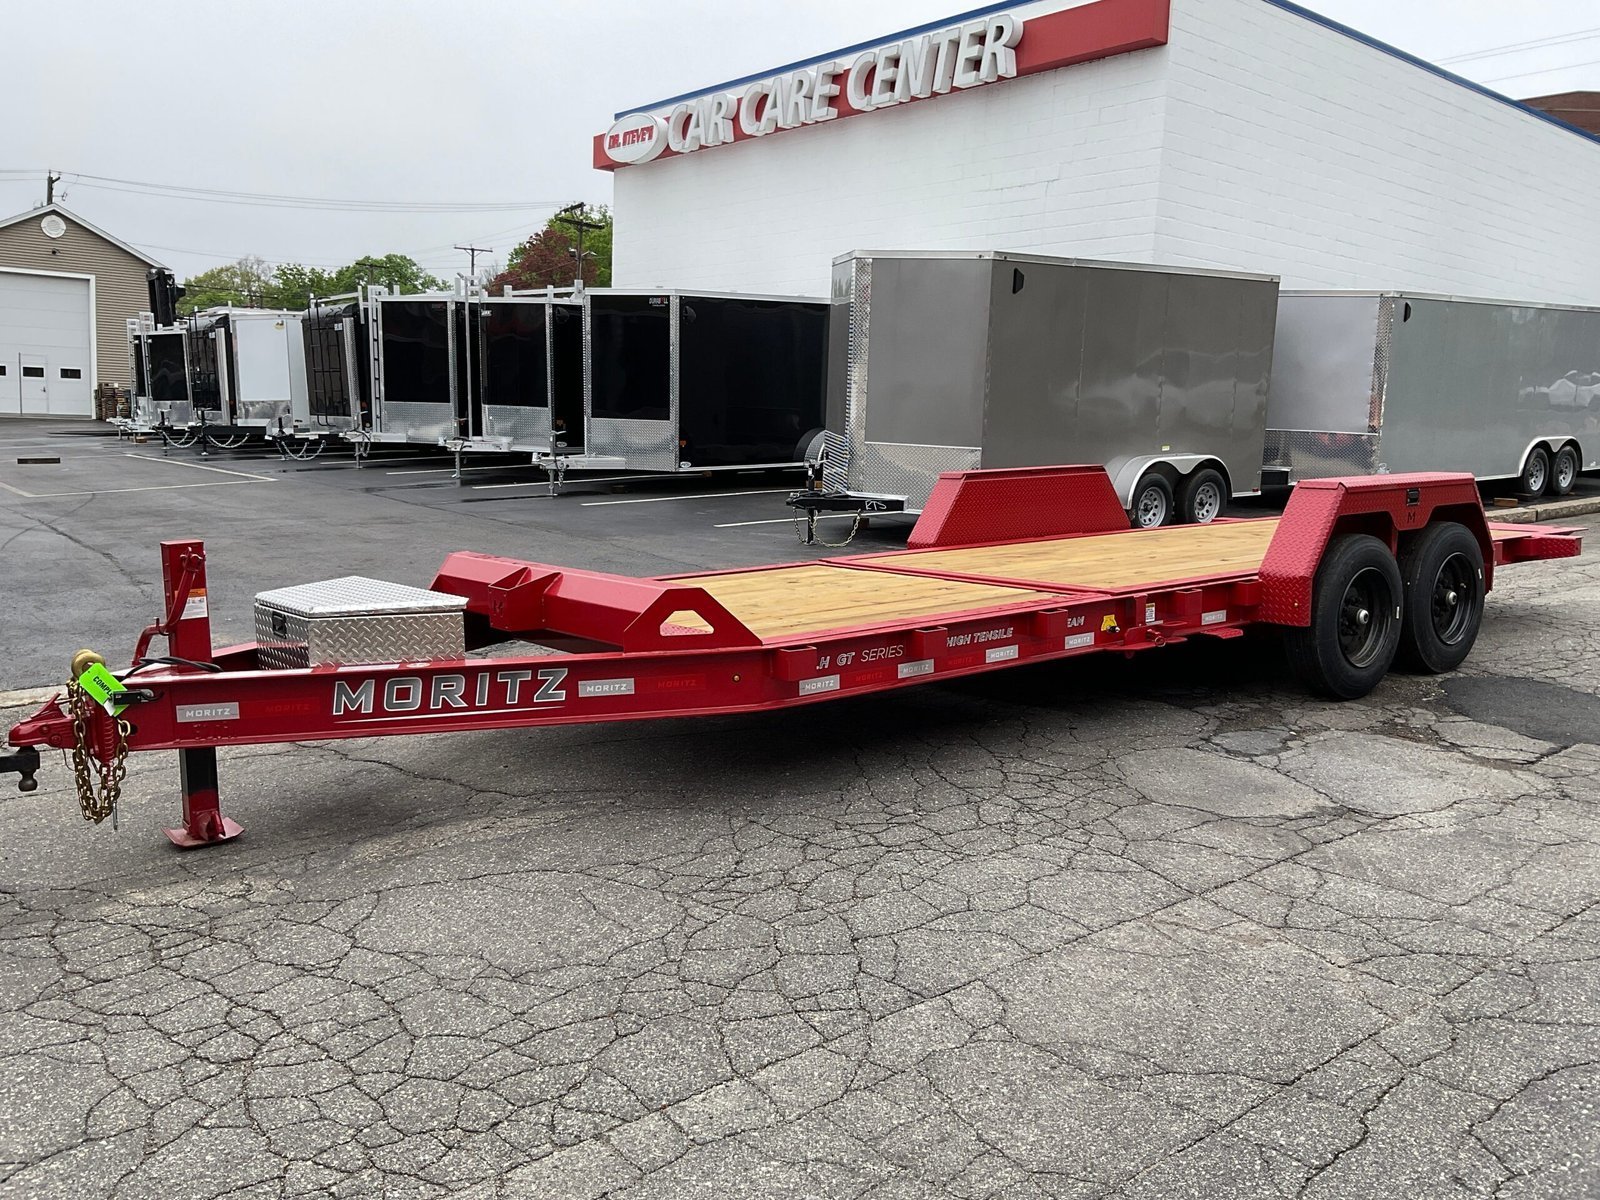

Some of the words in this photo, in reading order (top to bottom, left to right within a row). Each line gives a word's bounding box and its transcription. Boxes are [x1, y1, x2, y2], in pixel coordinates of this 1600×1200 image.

[668, 93, 737, 153] CAR
[740, 62, 841, 136] CARE
[847, 14, 1023, 111] CENTER
[946, 633, 972, 648] HIGH
[973, 627, 1014, 644] TENSILE
[816, 656, 831, 670] H
[836, 651, 856, 666] GT
[860, 645, 904, 662] SERIES
[990, 650, 1014, 660] MORITZ
[902, 664, 930, 674] MORITZ
[586, 683, 628, 693] MORITZ
[804, 680, 835, 691] MORITZ
[332, 668, 568, 716] MORITZ
[185, 707, 231, 718] MORITZ
